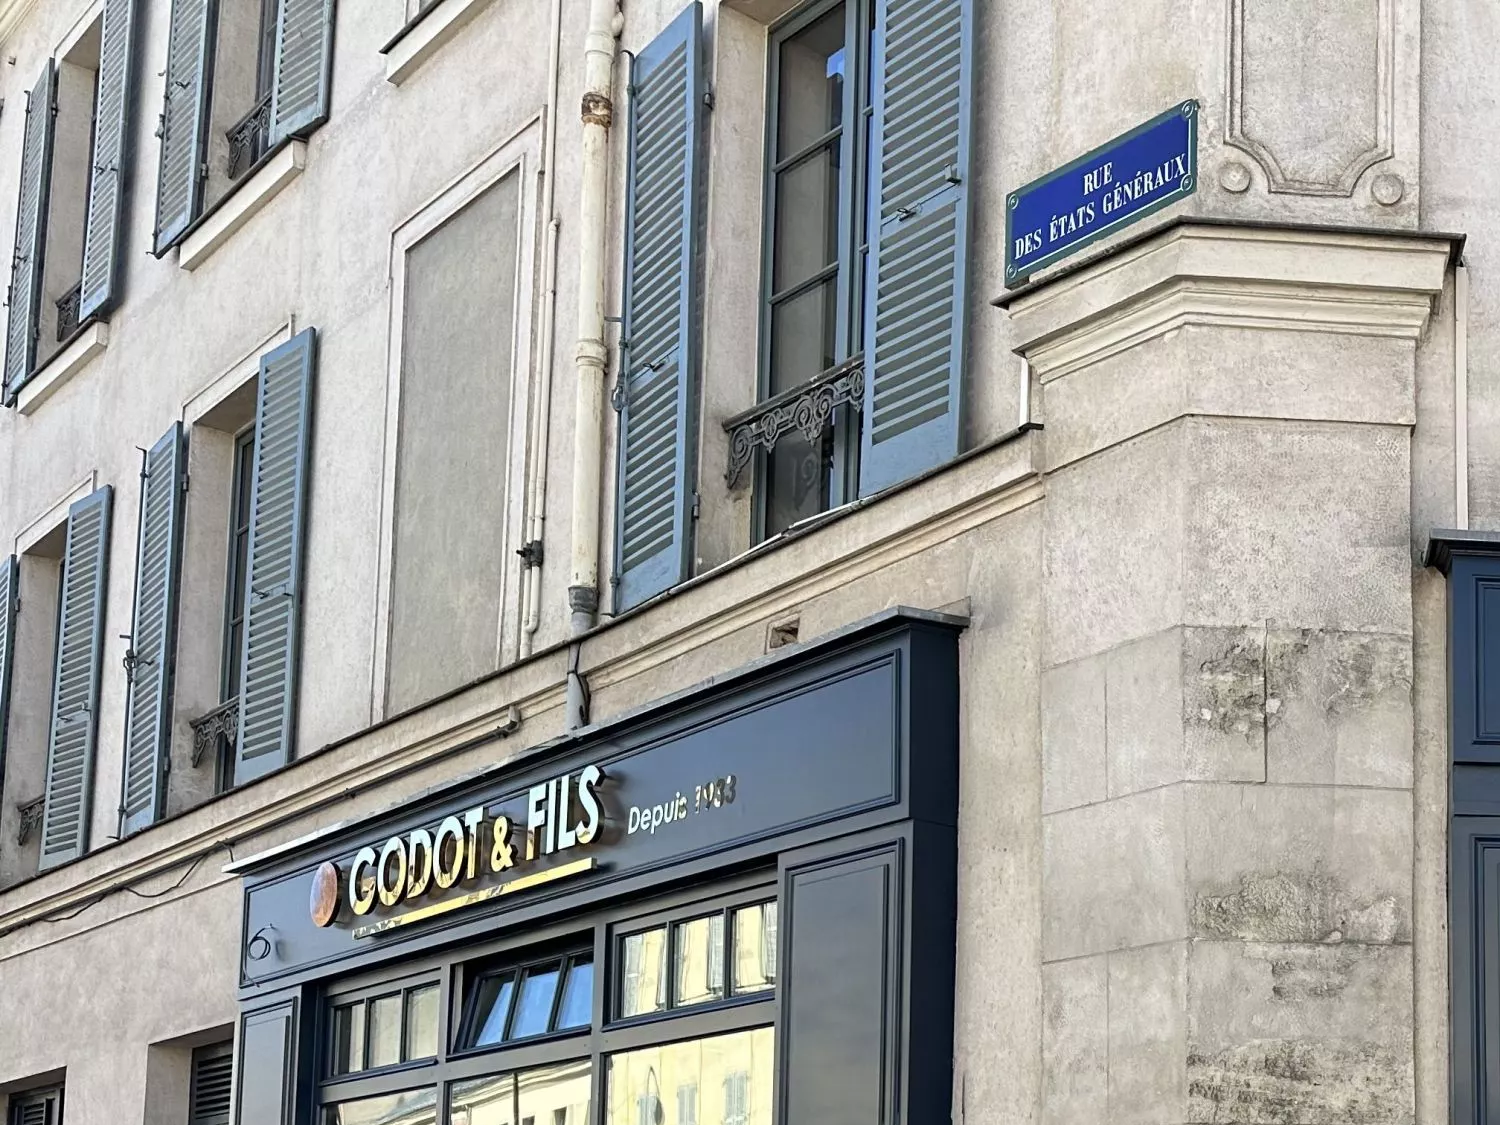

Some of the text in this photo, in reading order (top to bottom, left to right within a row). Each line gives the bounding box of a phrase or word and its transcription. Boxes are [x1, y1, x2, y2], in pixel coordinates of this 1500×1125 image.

[1015, 153, 1186, 260] DES ÉTATS GÉNÉRAUX
[1083, 162, 1113, 196] RUE
[349, 764, 605, 917] GODOT & FILS
[627, 774, 737, 835] Depuis 1933
